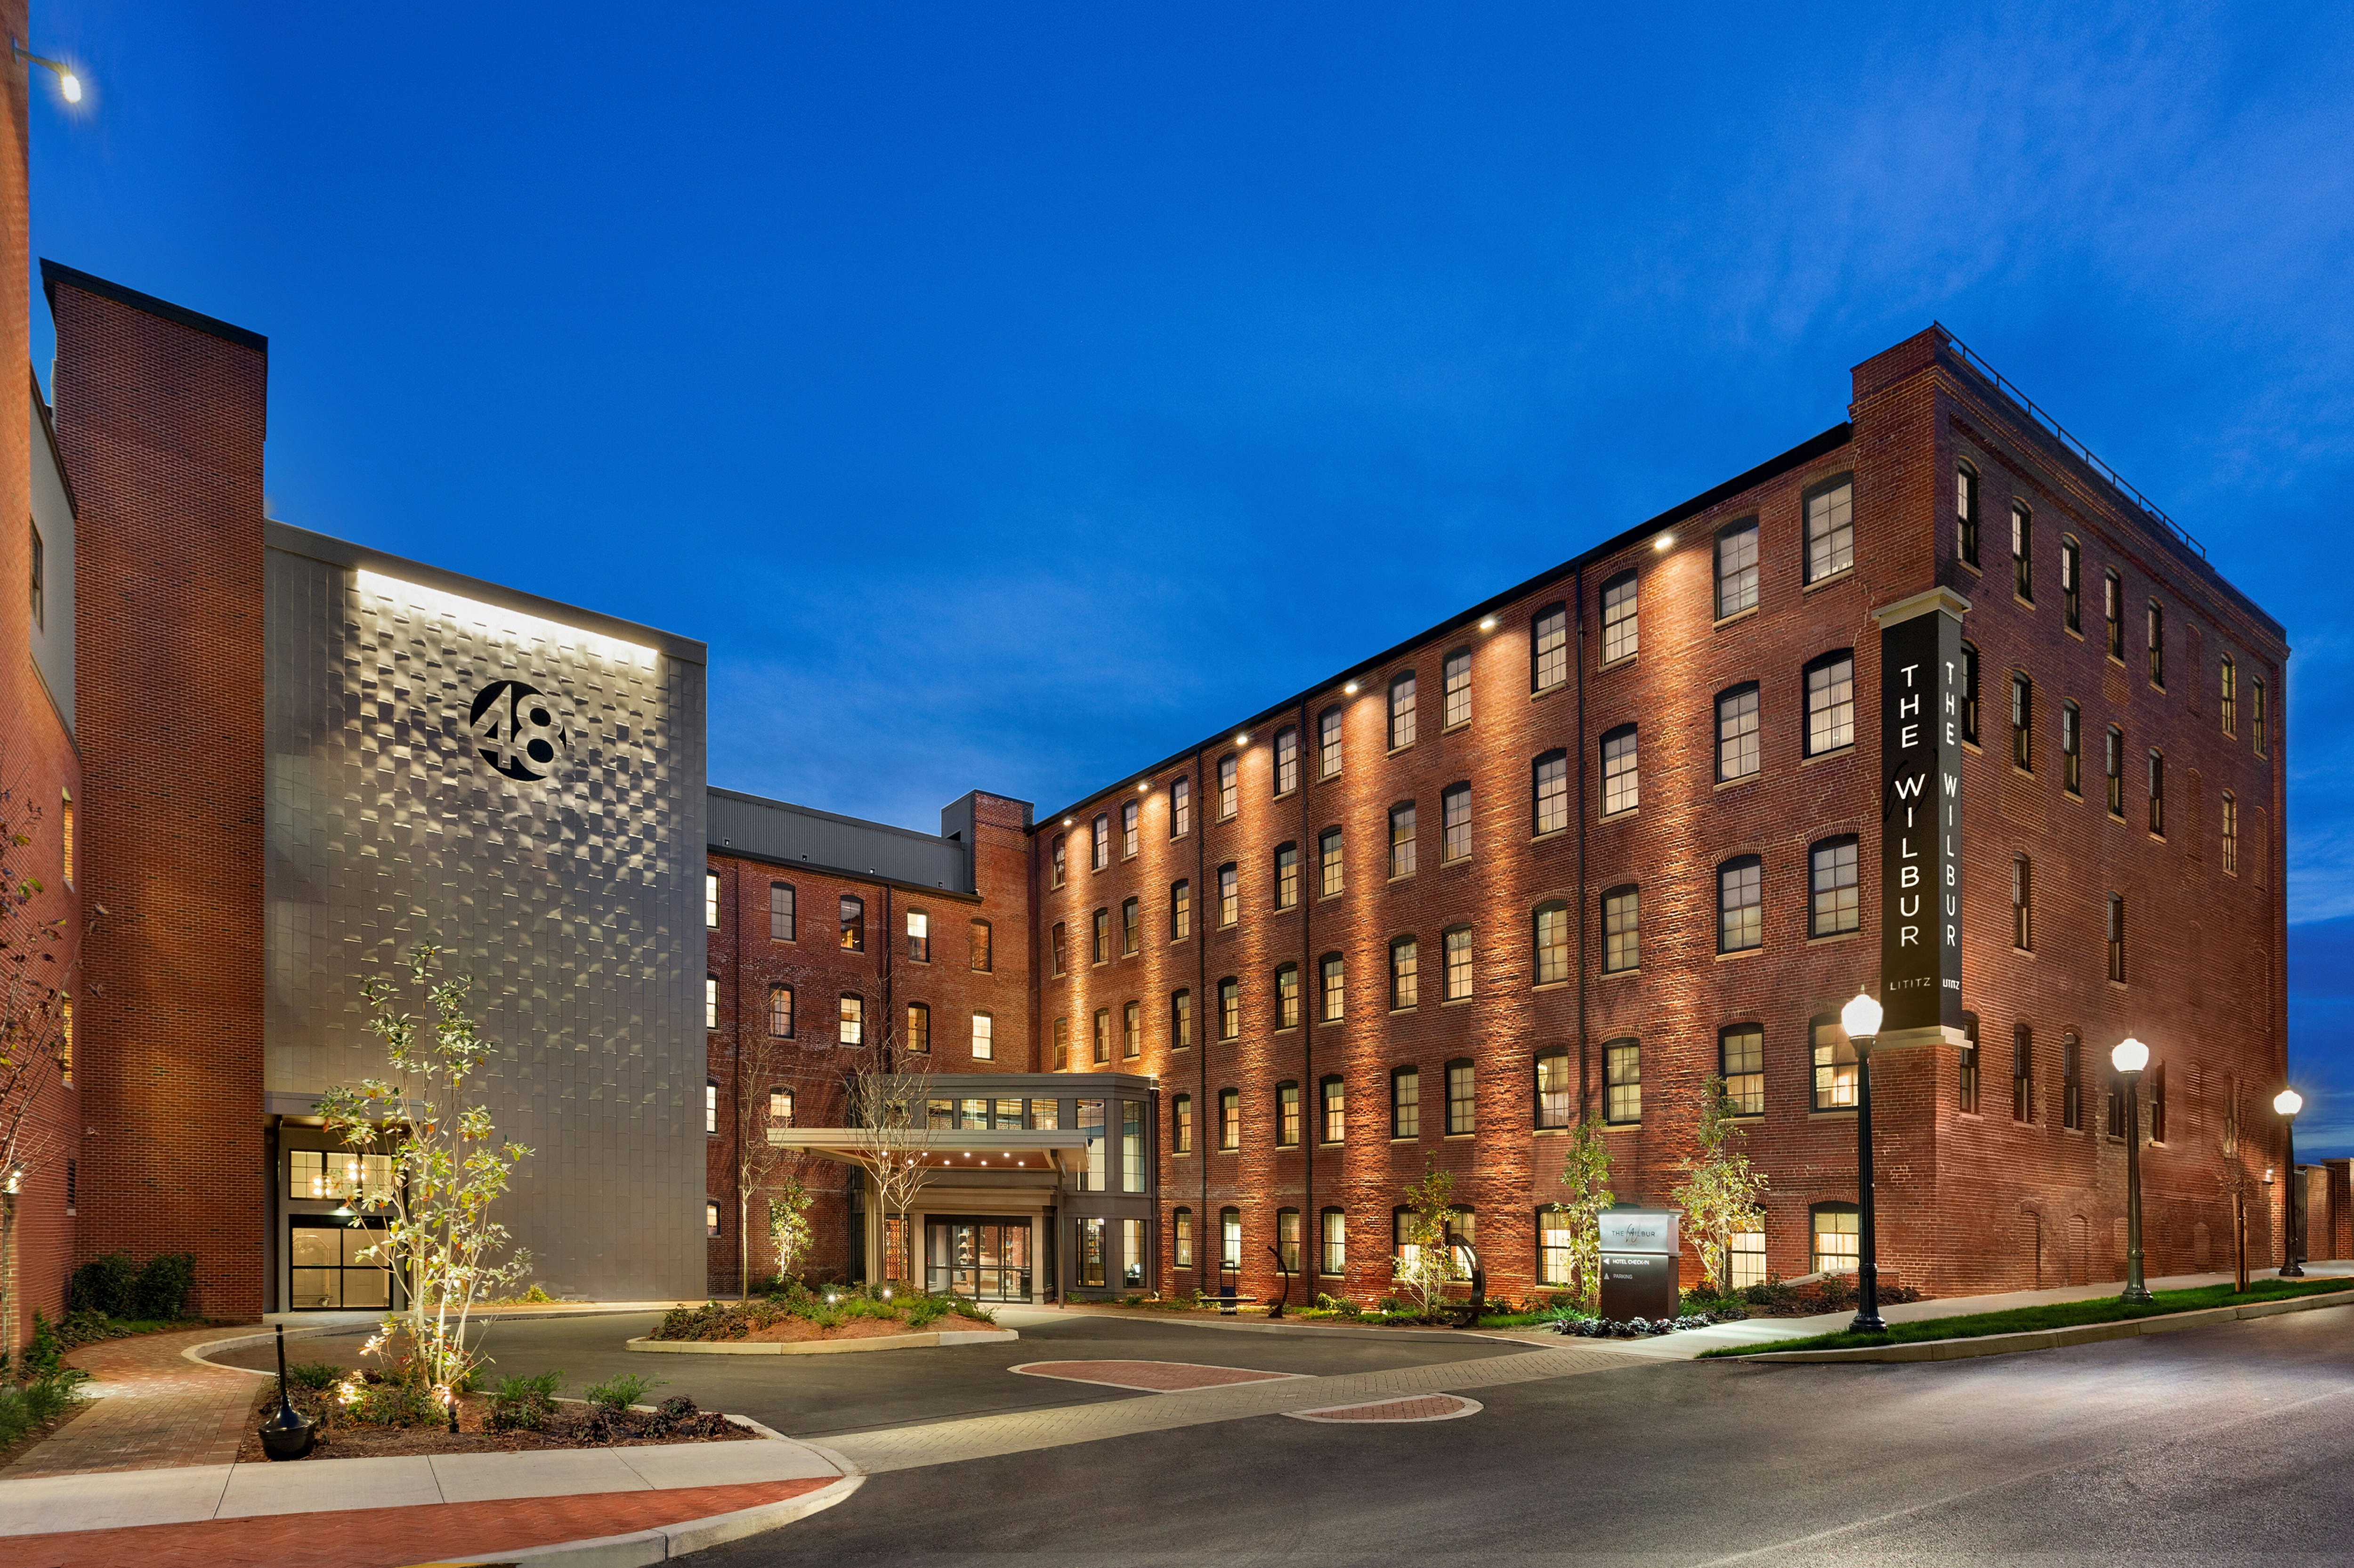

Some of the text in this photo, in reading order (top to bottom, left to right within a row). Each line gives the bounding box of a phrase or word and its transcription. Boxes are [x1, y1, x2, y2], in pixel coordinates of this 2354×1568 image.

[469, 683, 566, 778] 48
[1894, 663, 1925, 947] THE WILBUR
[1943, 661, 1958, 947] THE WILBUR
[1890, 977, 1931, 990] LITITZ
